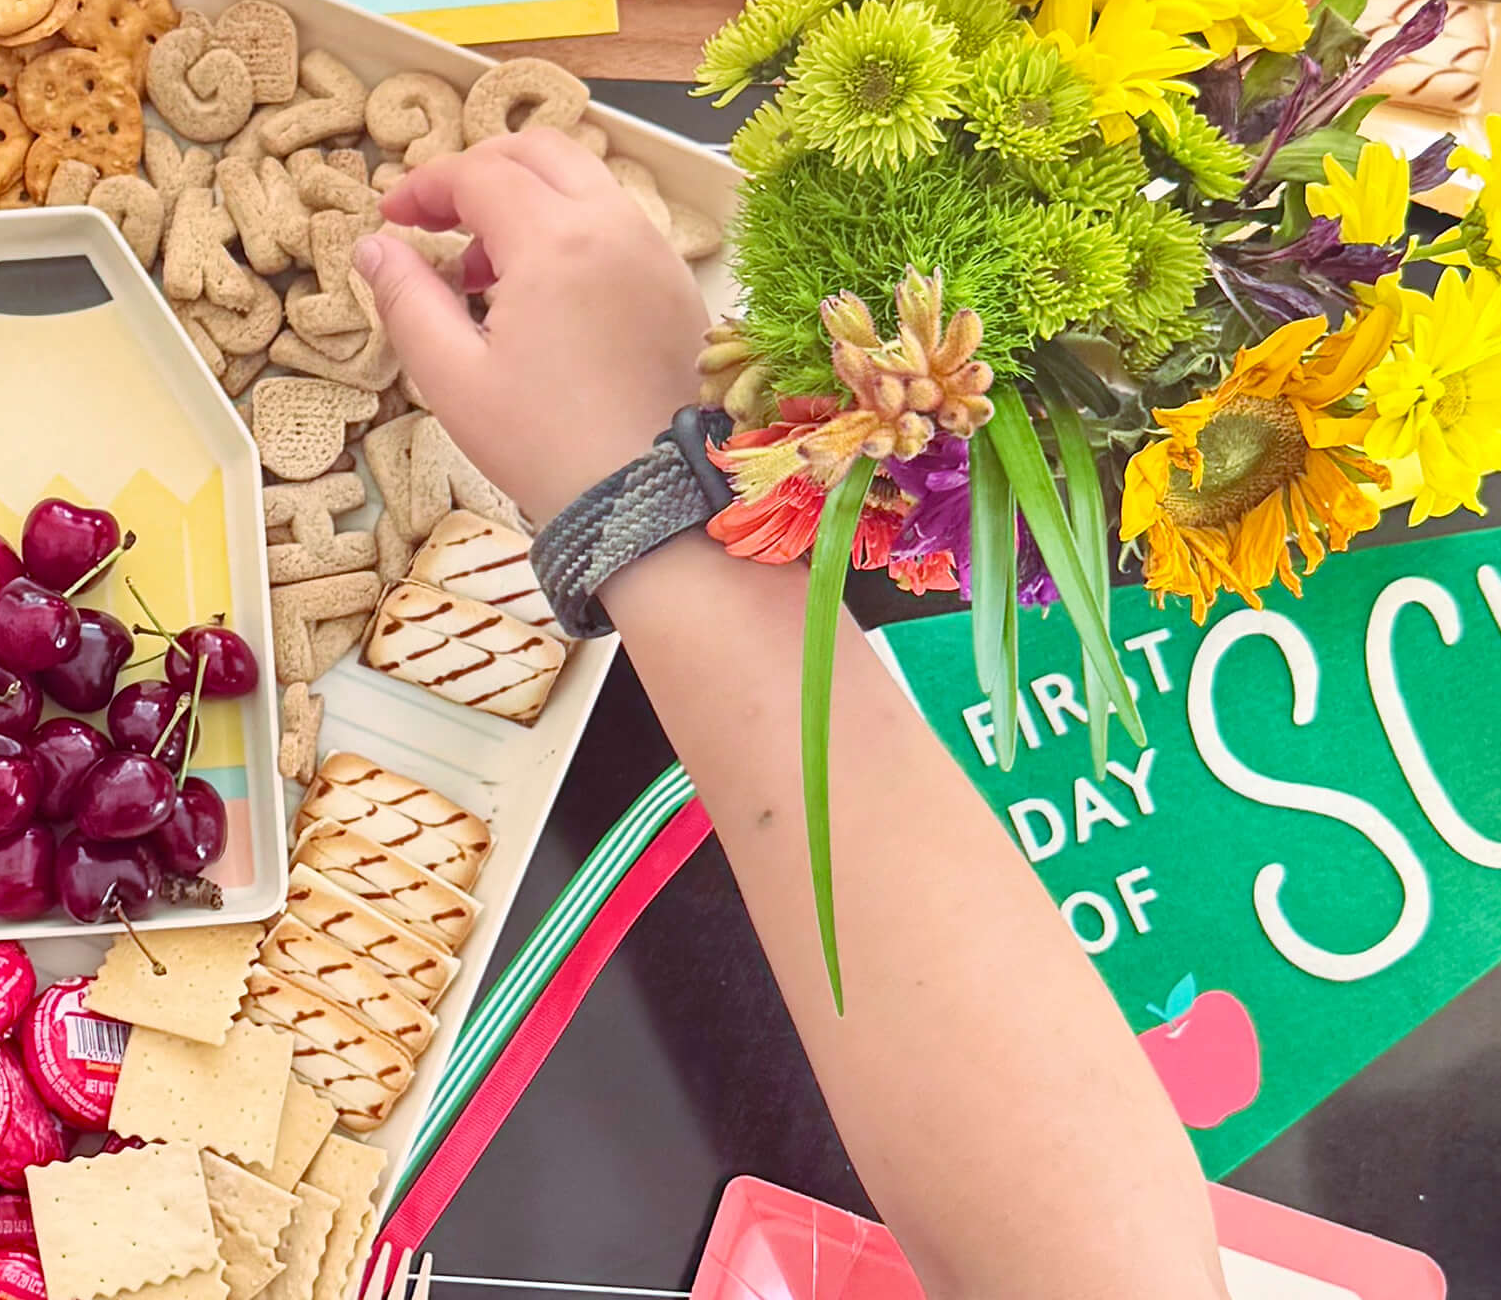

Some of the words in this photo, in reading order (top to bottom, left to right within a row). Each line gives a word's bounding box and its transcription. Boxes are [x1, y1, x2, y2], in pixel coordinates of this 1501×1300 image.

[1007, 747, 1158, 862] DAY
[1187, 564, 1501, 981] SC
[1058, 866, 1160, 955] OF
